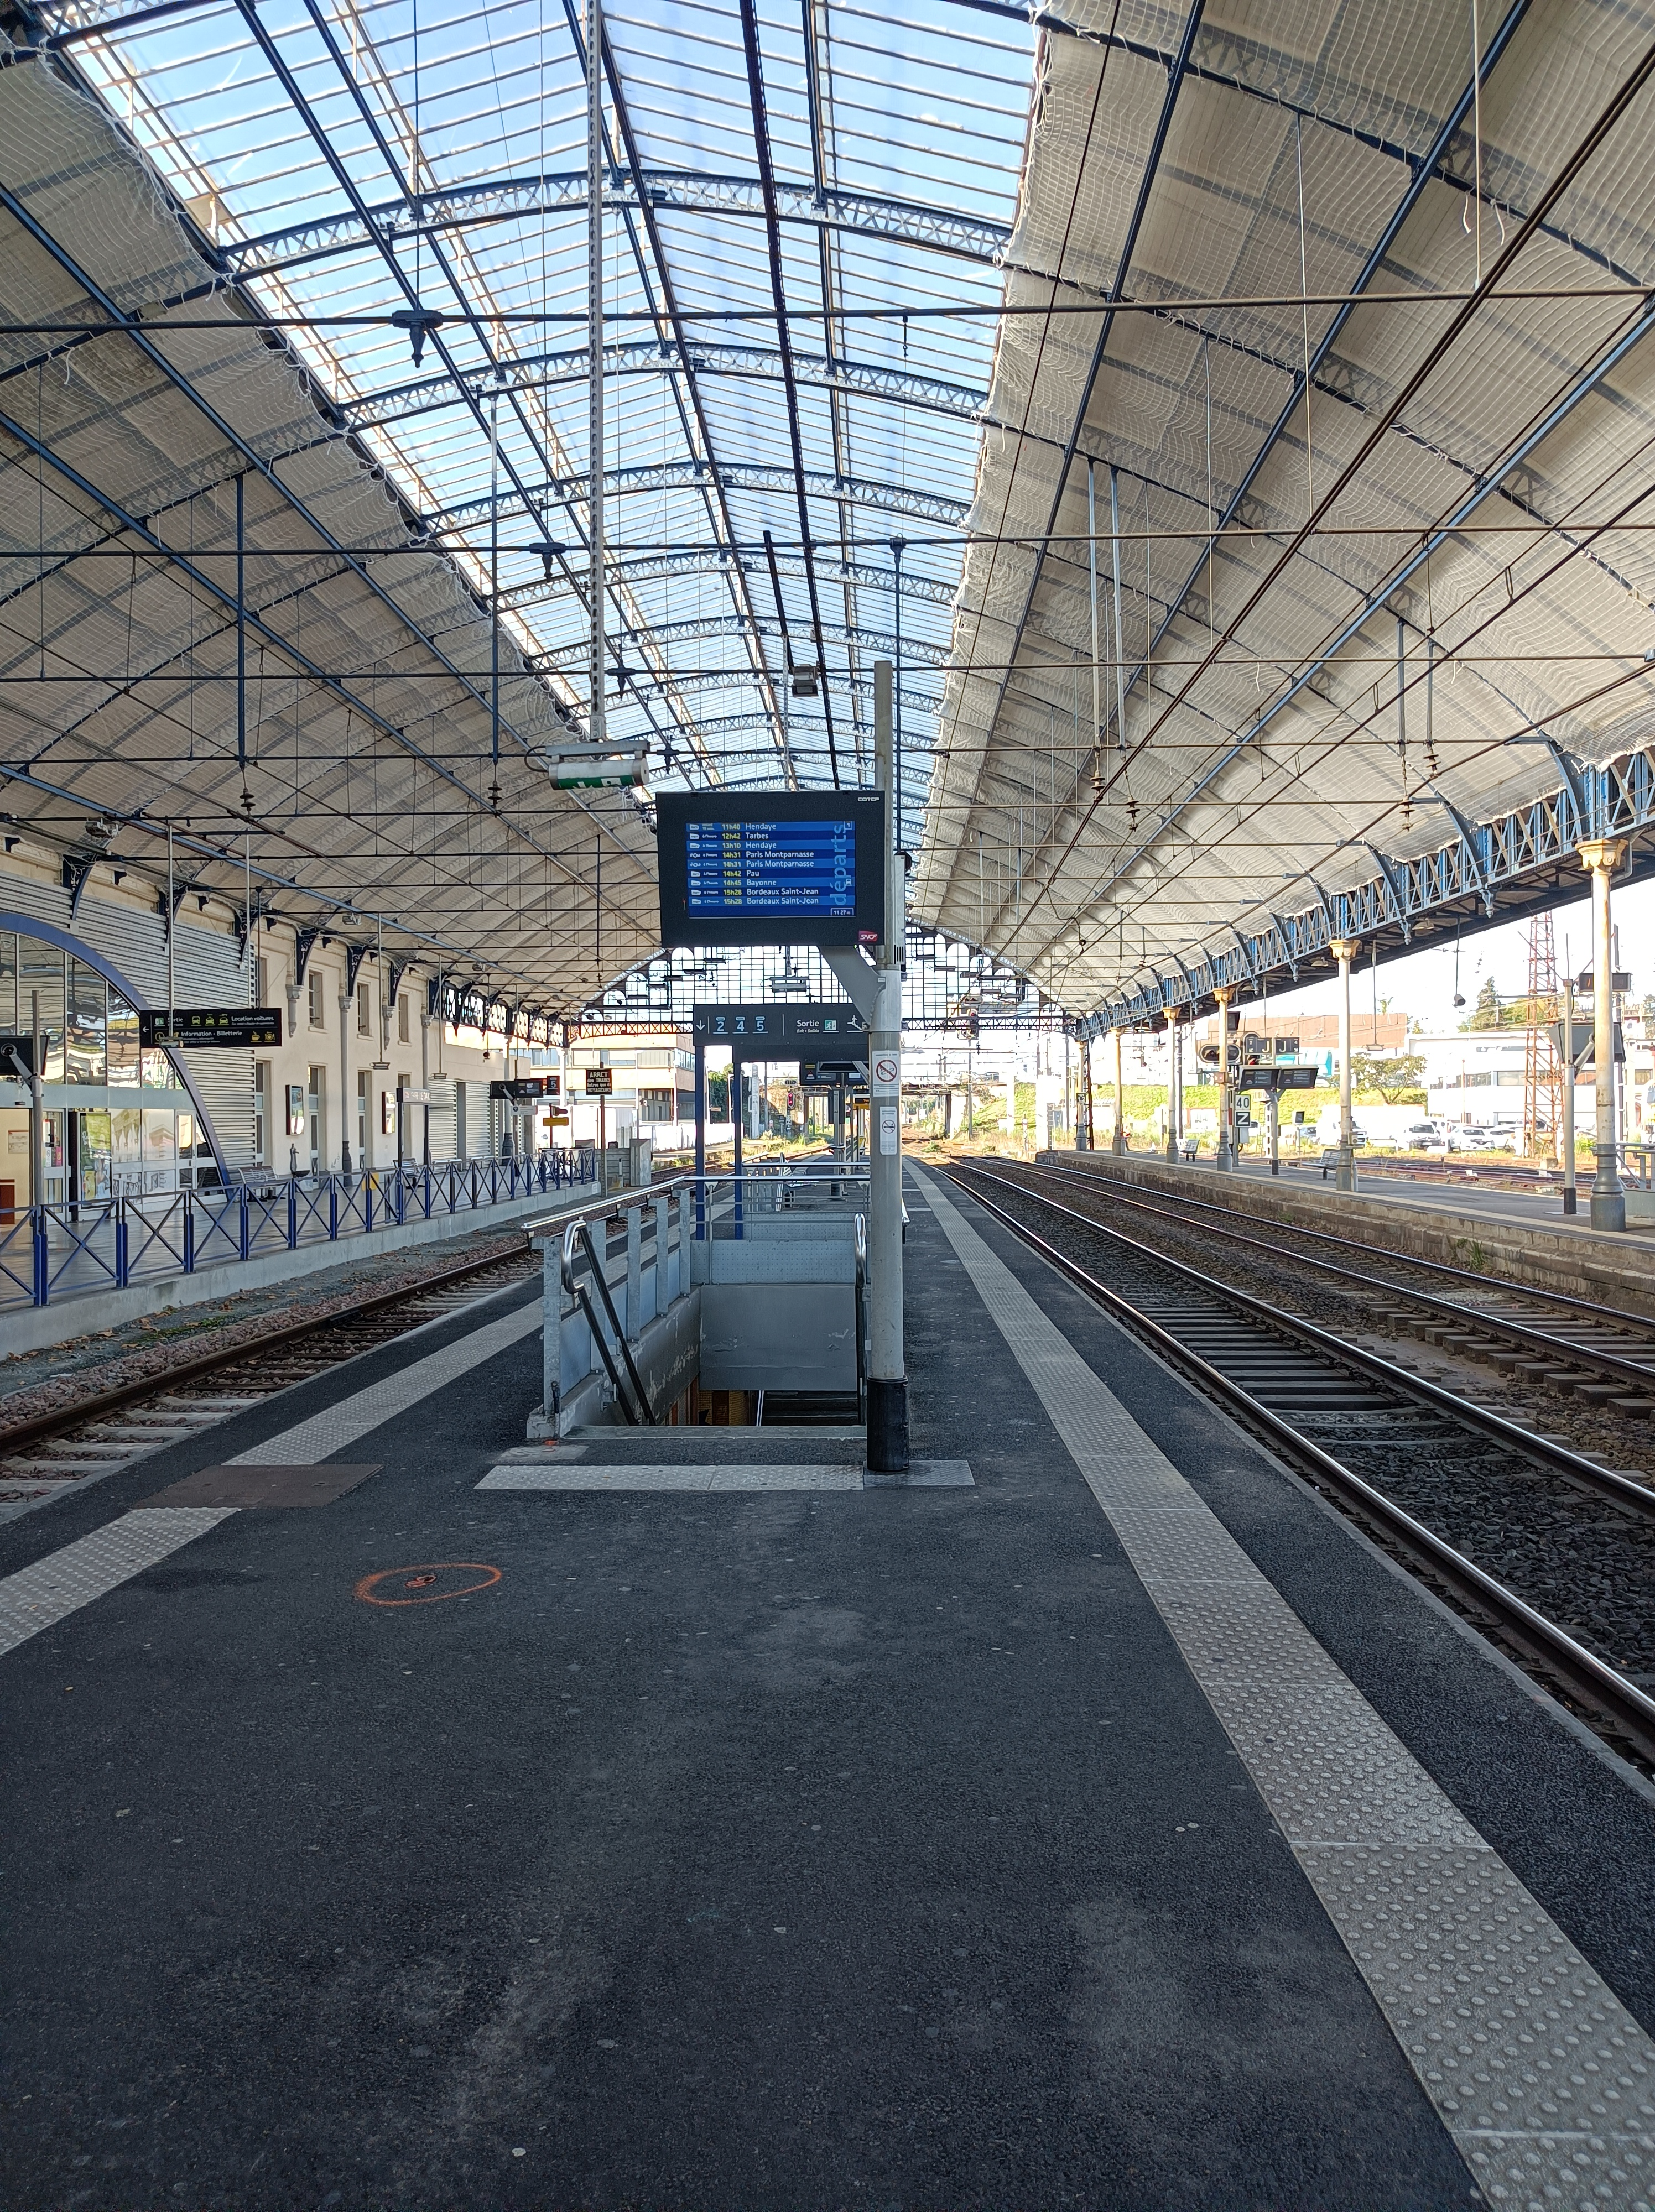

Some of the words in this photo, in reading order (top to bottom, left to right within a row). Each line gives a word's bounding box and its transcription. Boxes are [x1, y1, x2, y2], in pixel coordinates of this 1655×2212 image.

[745, 823, 777, 831] Hendaye
[746, 842, 777, 850] Hendaye
[764, 851, 814, 859] Montparnasse
[764, 860, 814, 869] Montparnasse
[829, 824, 851, 906] départs
[746, 879, 777, 887] Bayonne
[717, 1021, 725, 1032] 2
[737, 1021, 745, 1032] 4
[757, 1021, 764, 1032] 5
[1262, 1041, 1269, 1053] J
[1279, 1040, 1287, 1052] J
[1236, 1097, 1250, 1108] 40
[1237, 1113, 1249, 1125] Z
